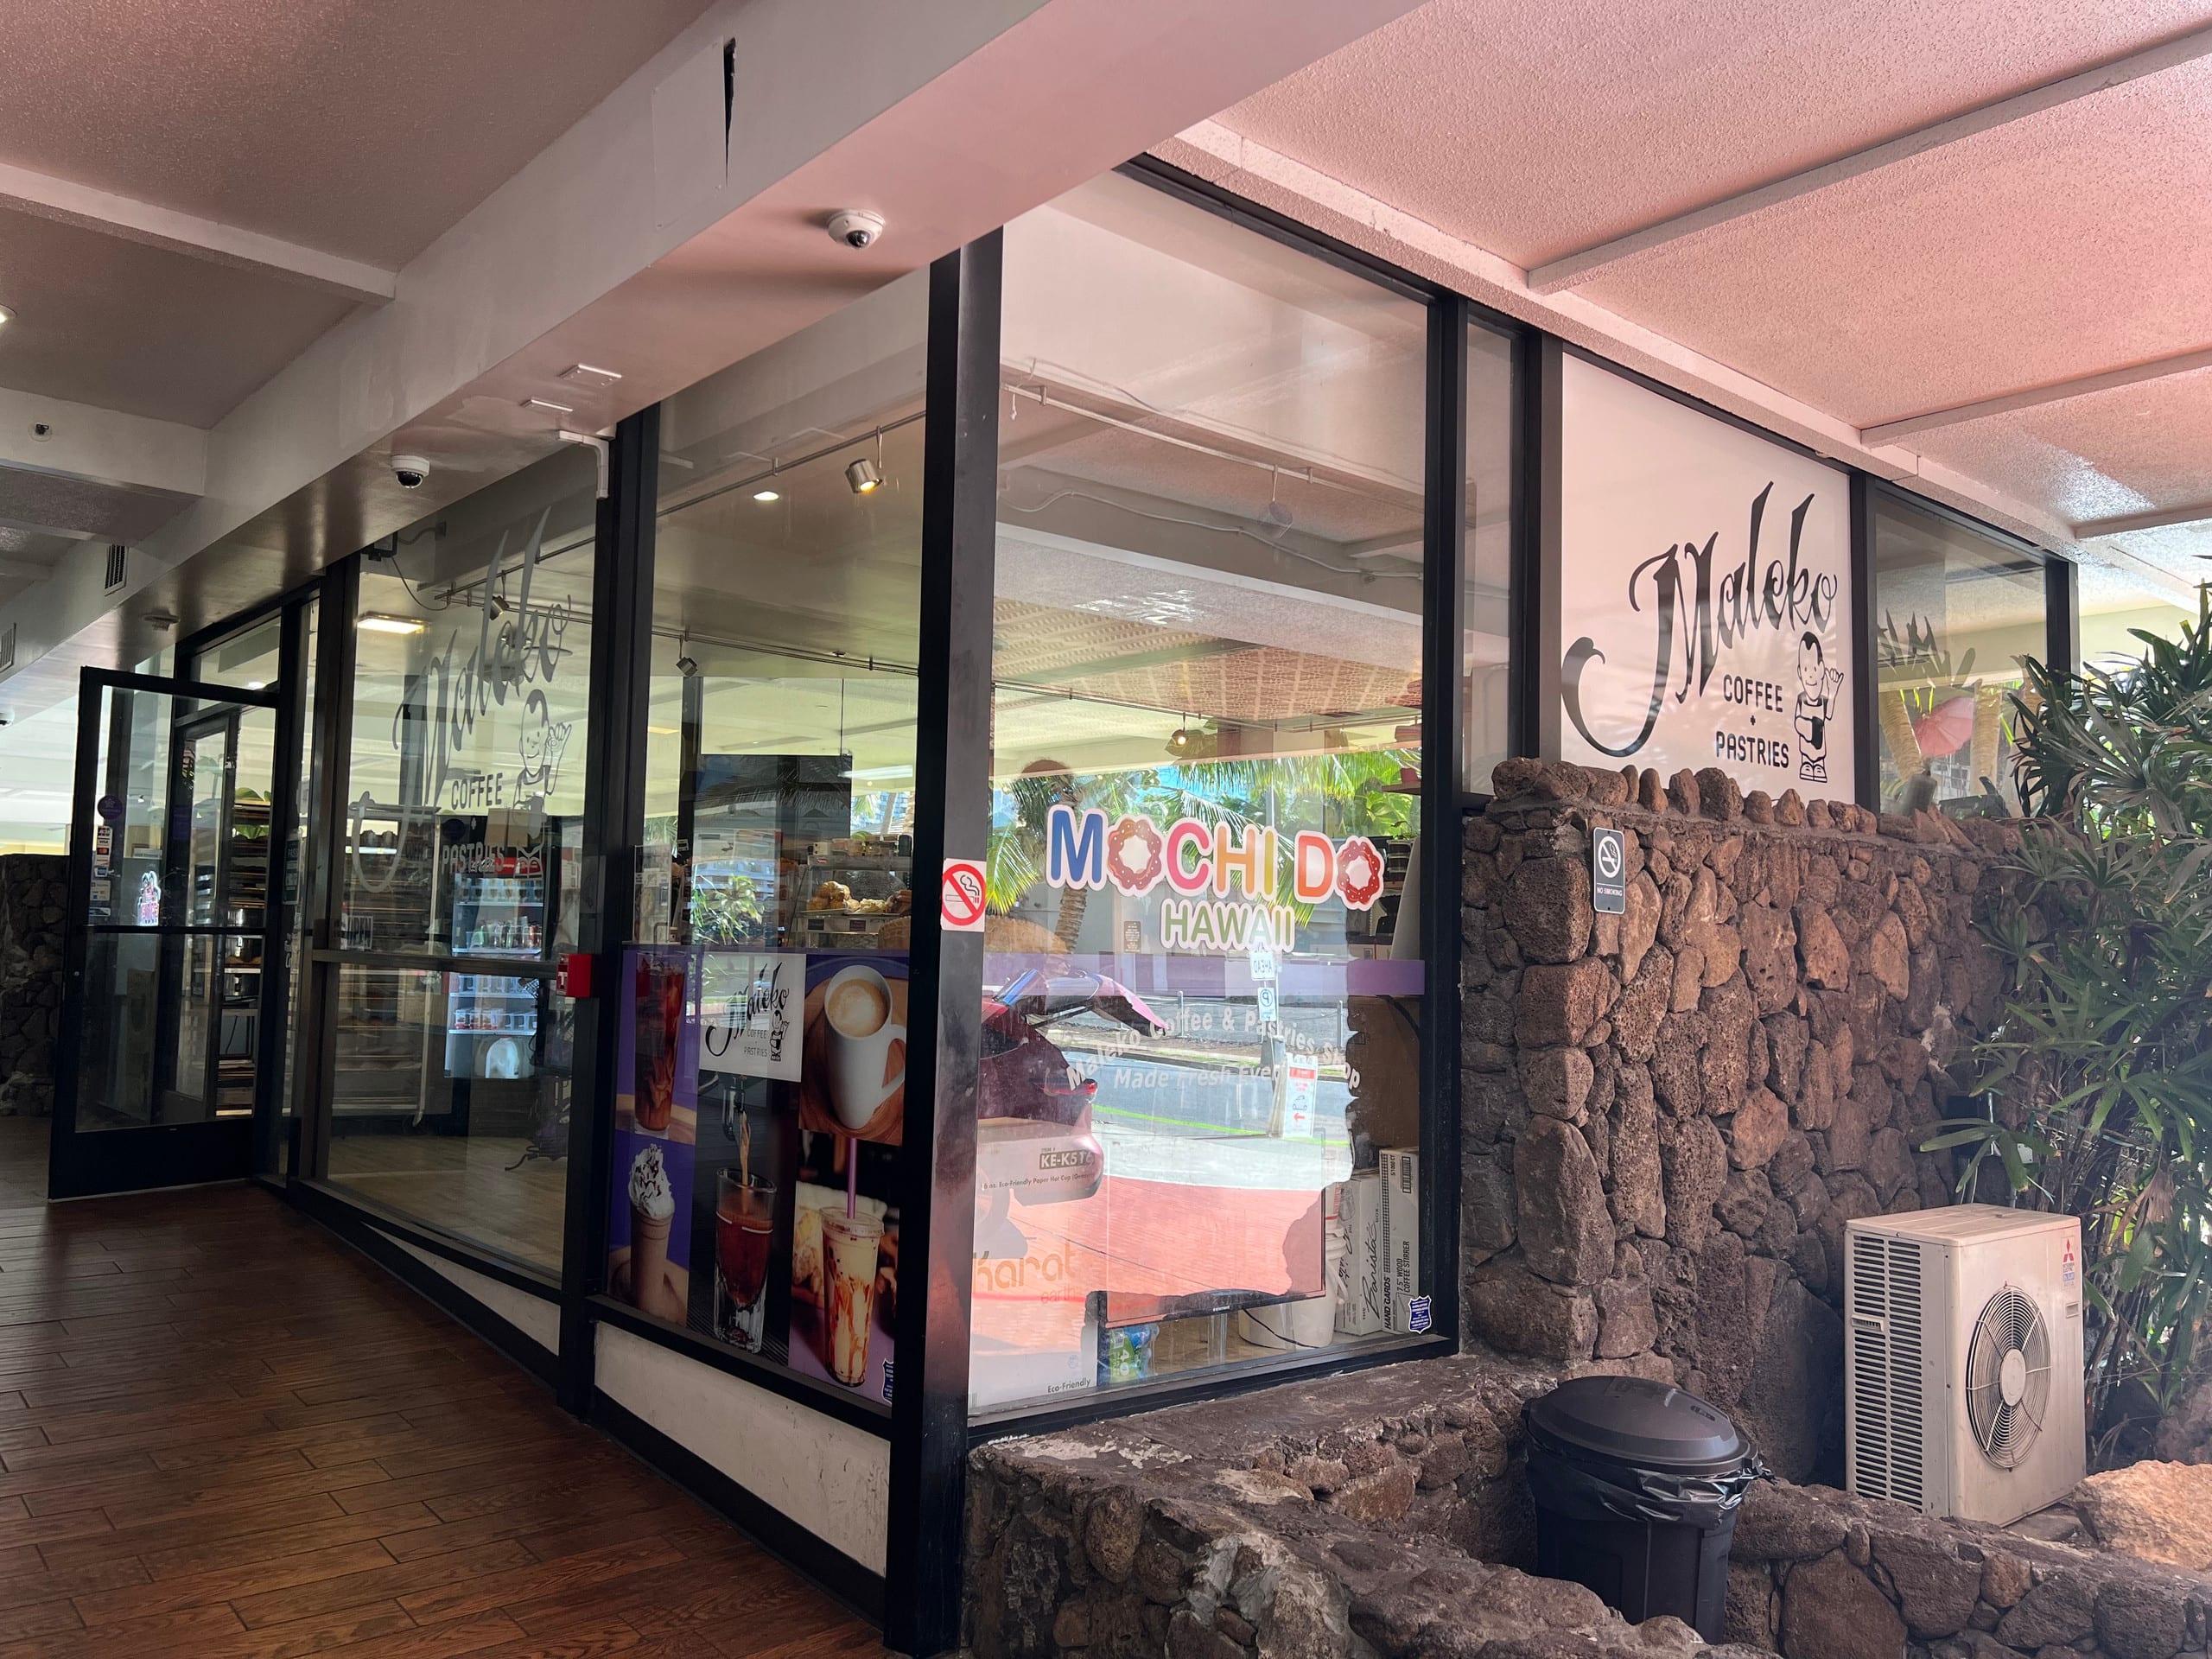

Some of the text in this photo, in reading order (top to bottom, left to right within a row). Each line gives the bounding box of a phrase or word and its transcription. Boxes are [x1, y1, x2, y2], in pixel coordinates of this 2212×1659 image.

[1561, 480, 1837, 758] Maleko
[352, 505, 572, 893] Maleko
[1723, 674, 1783, 713] COFFEE
[1716, 730, 1790, 769] PASTRIES
[451, 772, 504, 810] COFFEE
[442, 842, 505, 874] PASTRIES
[1048, 806, 1383, 911] MOCHI DO
[1604, 887, 1623, 896] SMOKING
[1163, 899, 1294, 951] HAWAII
[705, 962, 790, 1057] Maleko
[744, 1046, 767, 1057] PASTRIES
[747, 1029, 767, 1039] COFFEE
[1066, 1029, 1141, 1090] Maleko
[1149, 1009, 1212, 1039] Coffee
[1223, 1007, 1236, 1031] &
[1244, 1009, 1315, 1053] Pastries
[1113, 1067, 1169, 1089] Made
[1176, 1064, 1231, 1086] Fresh
[1061, 1174, 1071, 1183] Cup
[1363, 1222, 1381, 1319] Barista
[1382, 1277, 1391, 1305] GARDS
[1047, 1377, 1091, 1395] Eco-Friendly
